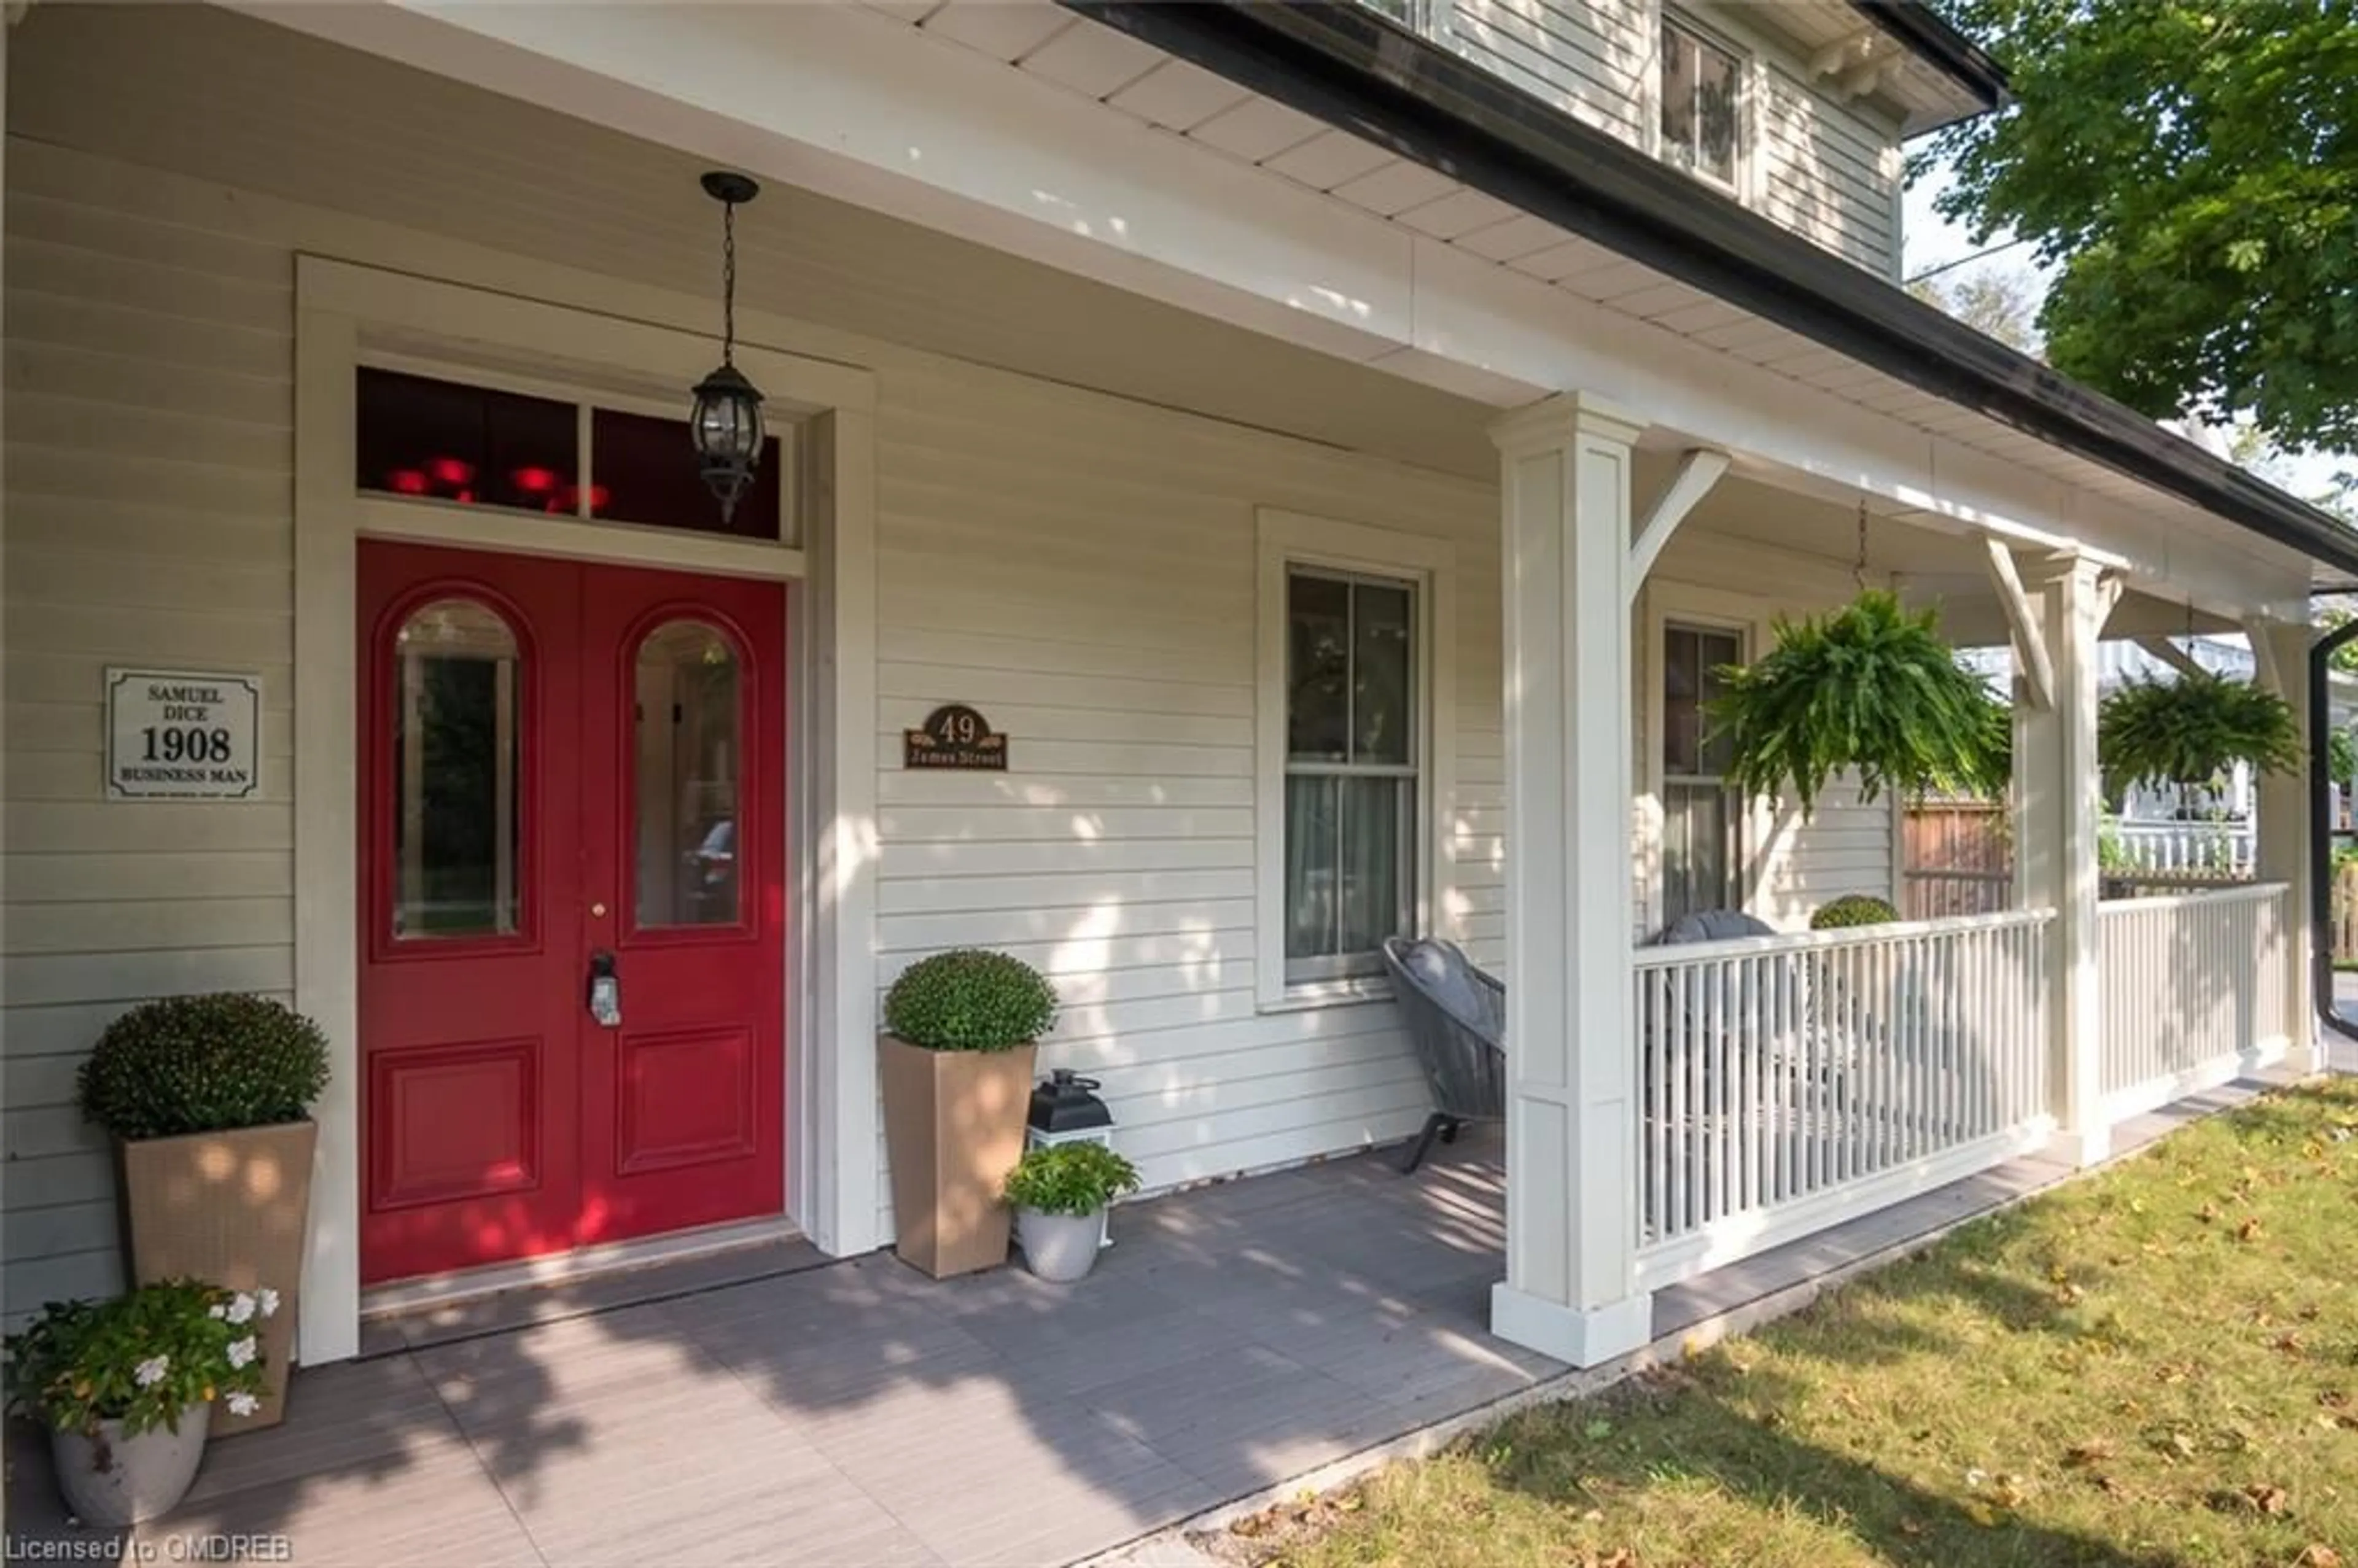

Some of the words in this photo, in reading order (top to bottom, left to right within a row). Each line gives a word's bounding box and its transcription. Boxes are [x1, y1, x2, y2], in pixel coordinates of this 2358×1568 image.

[148, 685, 224, 703] SAMUEL
[163, 705, 208, 721] DICE
[940, 714, 975, 743] 49
[141, 726, 230, 763] 1908
[121, 768, 206, 782] BUSINESS
[209, 770, 247, 783] MAN
